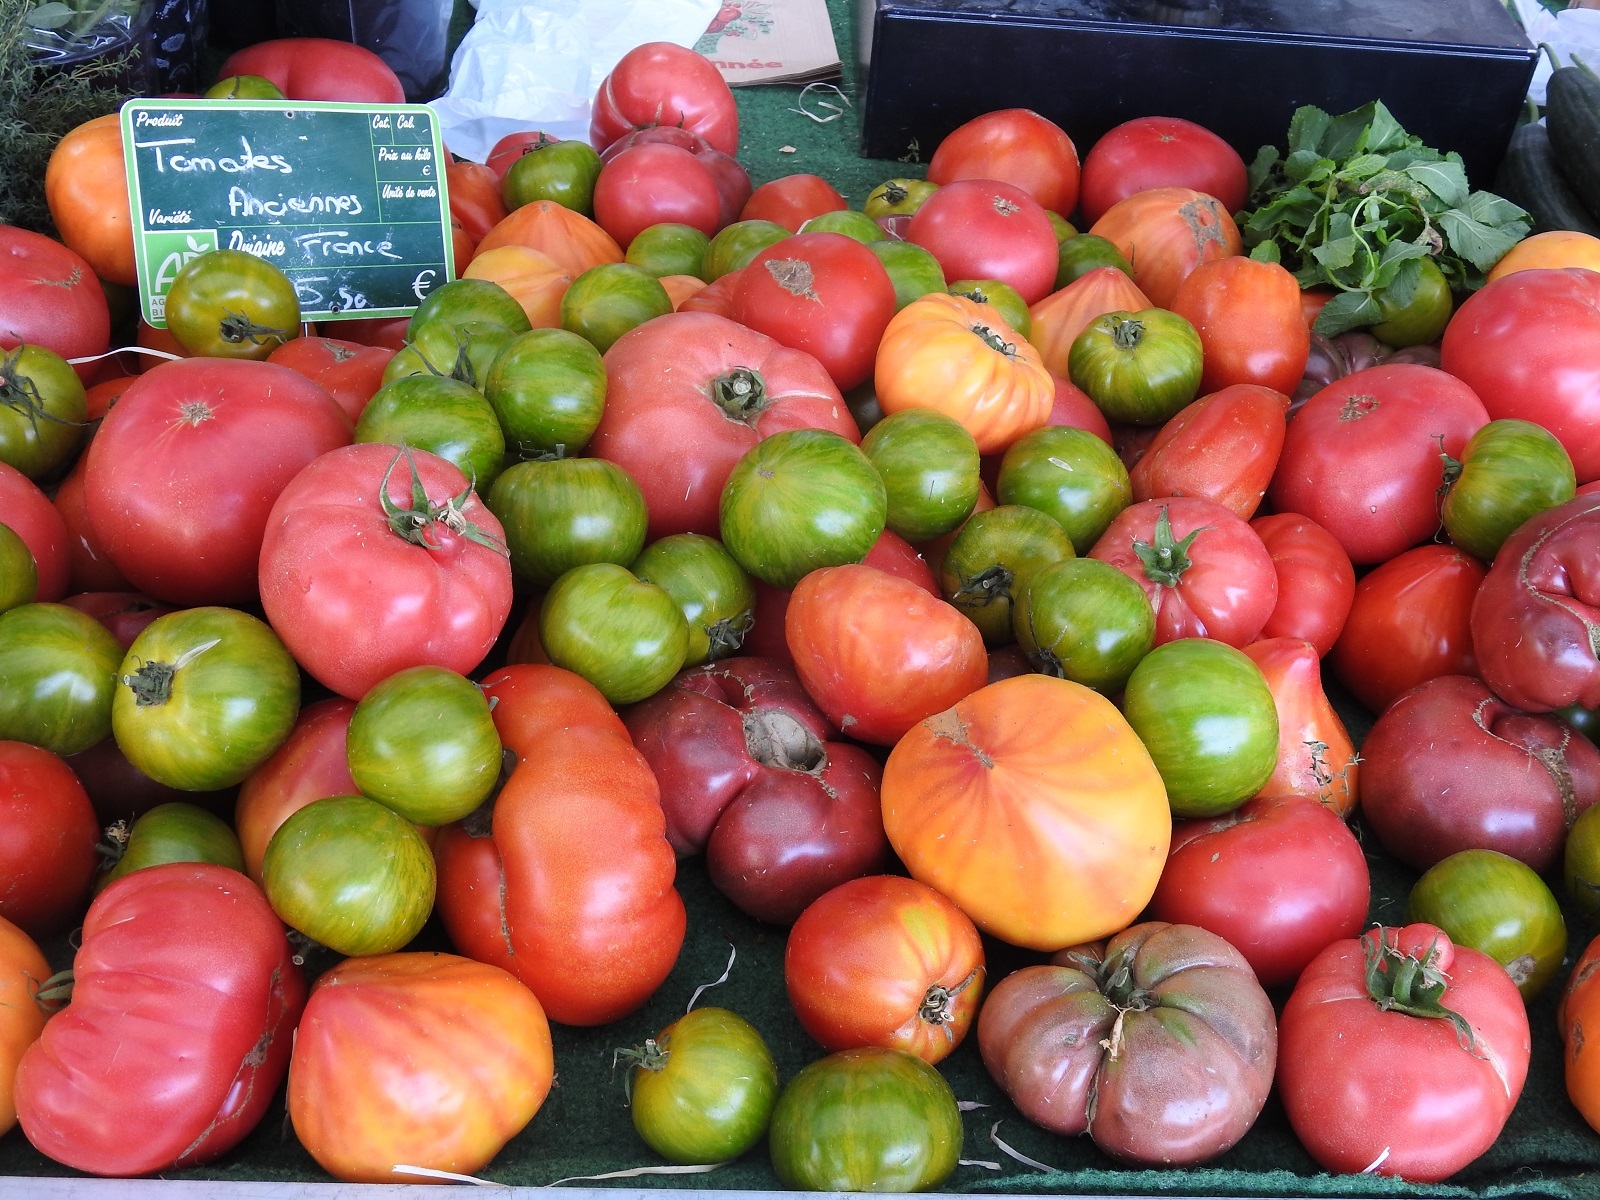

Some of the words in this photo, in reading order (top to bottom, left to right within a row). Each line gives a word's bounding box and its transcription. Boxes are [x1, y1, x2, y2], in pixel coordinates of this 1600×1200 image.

[136, 111, 184, 127] Produit
[372, 114, 390, 129] Cat.
[397, 114, 415, 129] Cal.
[135, 135, 292, 174] Tomates
[378, 147, 399, 162] Prix
[401, 151, 413, 161] au
[414, 147, 432, 161] kilo
[422, 164, 432, 176] €
[382, 184, 404, 199] Unité
[405, 185, 416, 198] de
[417, 185, 437, 198] vente
[228, 186, 363, 217] Anciennes
[149, 208, 192, 226] Variété
[228, 230, 286, 257] Origine
[294, 230, 403, 260] France
[411, 269, 437, 300] €
